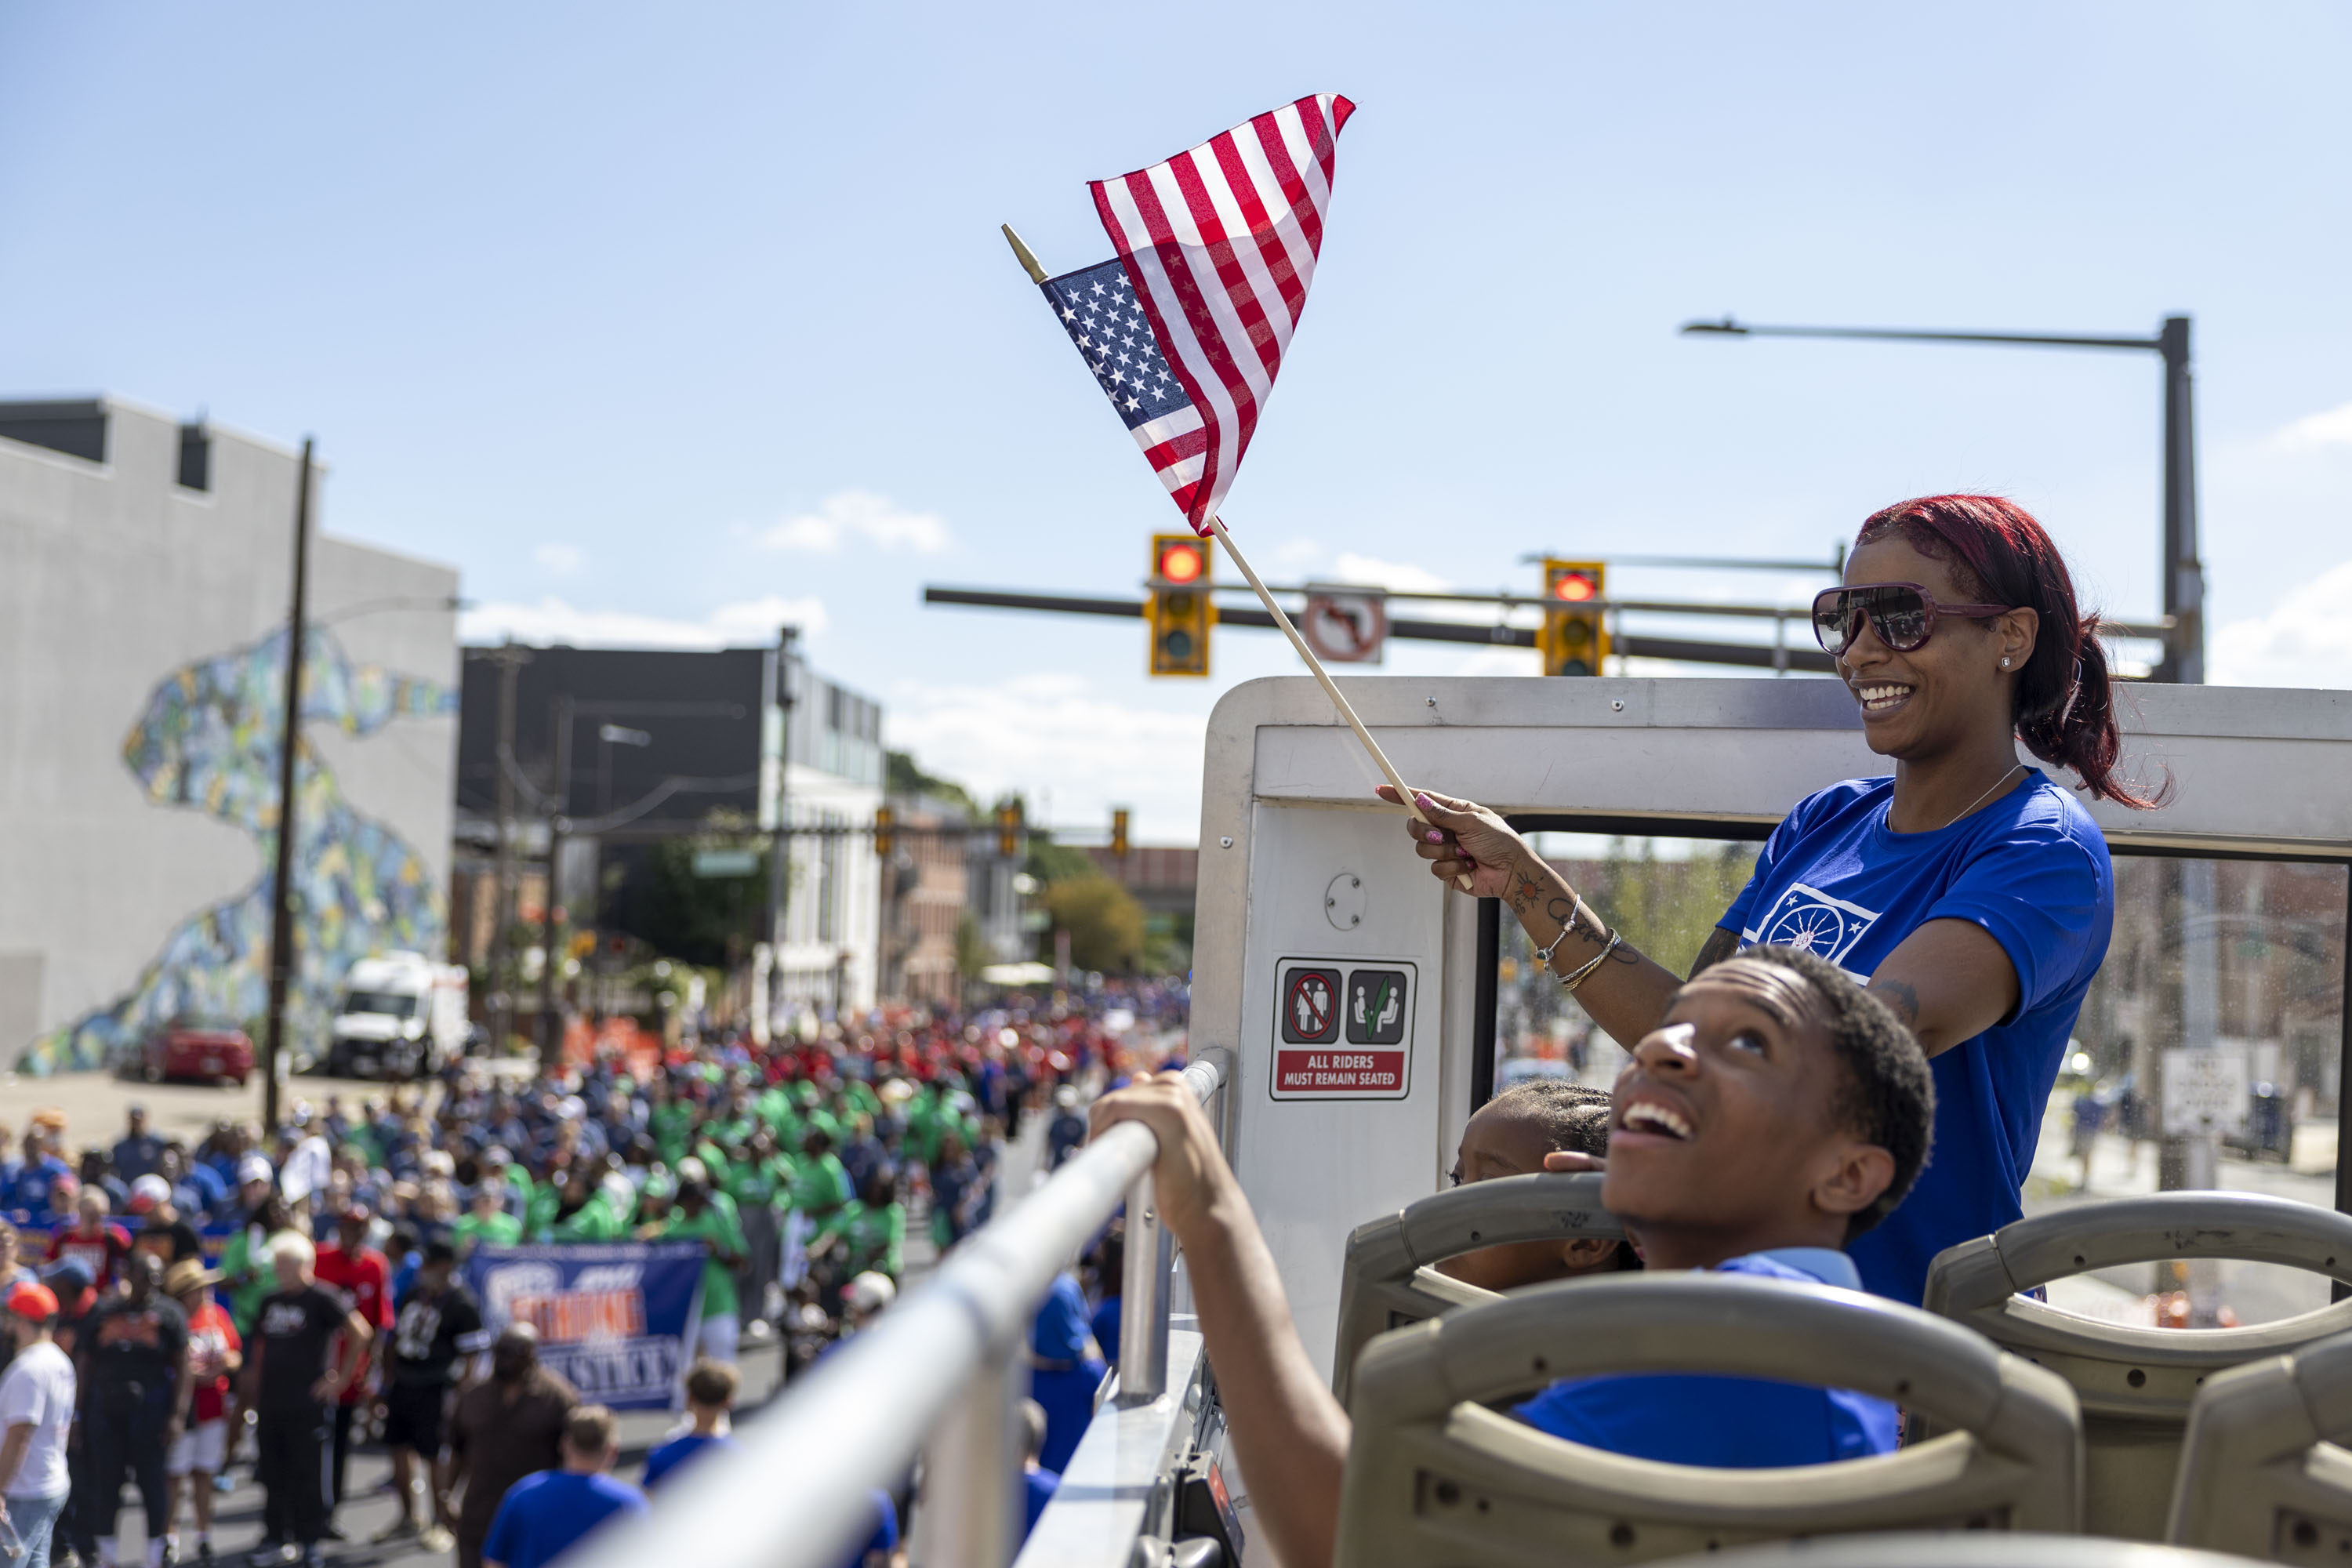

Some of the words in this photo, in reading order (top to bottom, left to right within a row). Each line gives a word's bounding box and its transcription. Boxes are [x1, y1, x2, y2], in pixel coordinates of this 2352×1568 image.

[1308, 1055, 1329, 1069] ALL
[1332, 1055, 1374, 1069] RIDERS
[1284, 1073, 1312, 1085] MUST
[1315, 1073, 1356, 1085] REMAIN
[1359, 1073, 1395, 1085] SEATED
